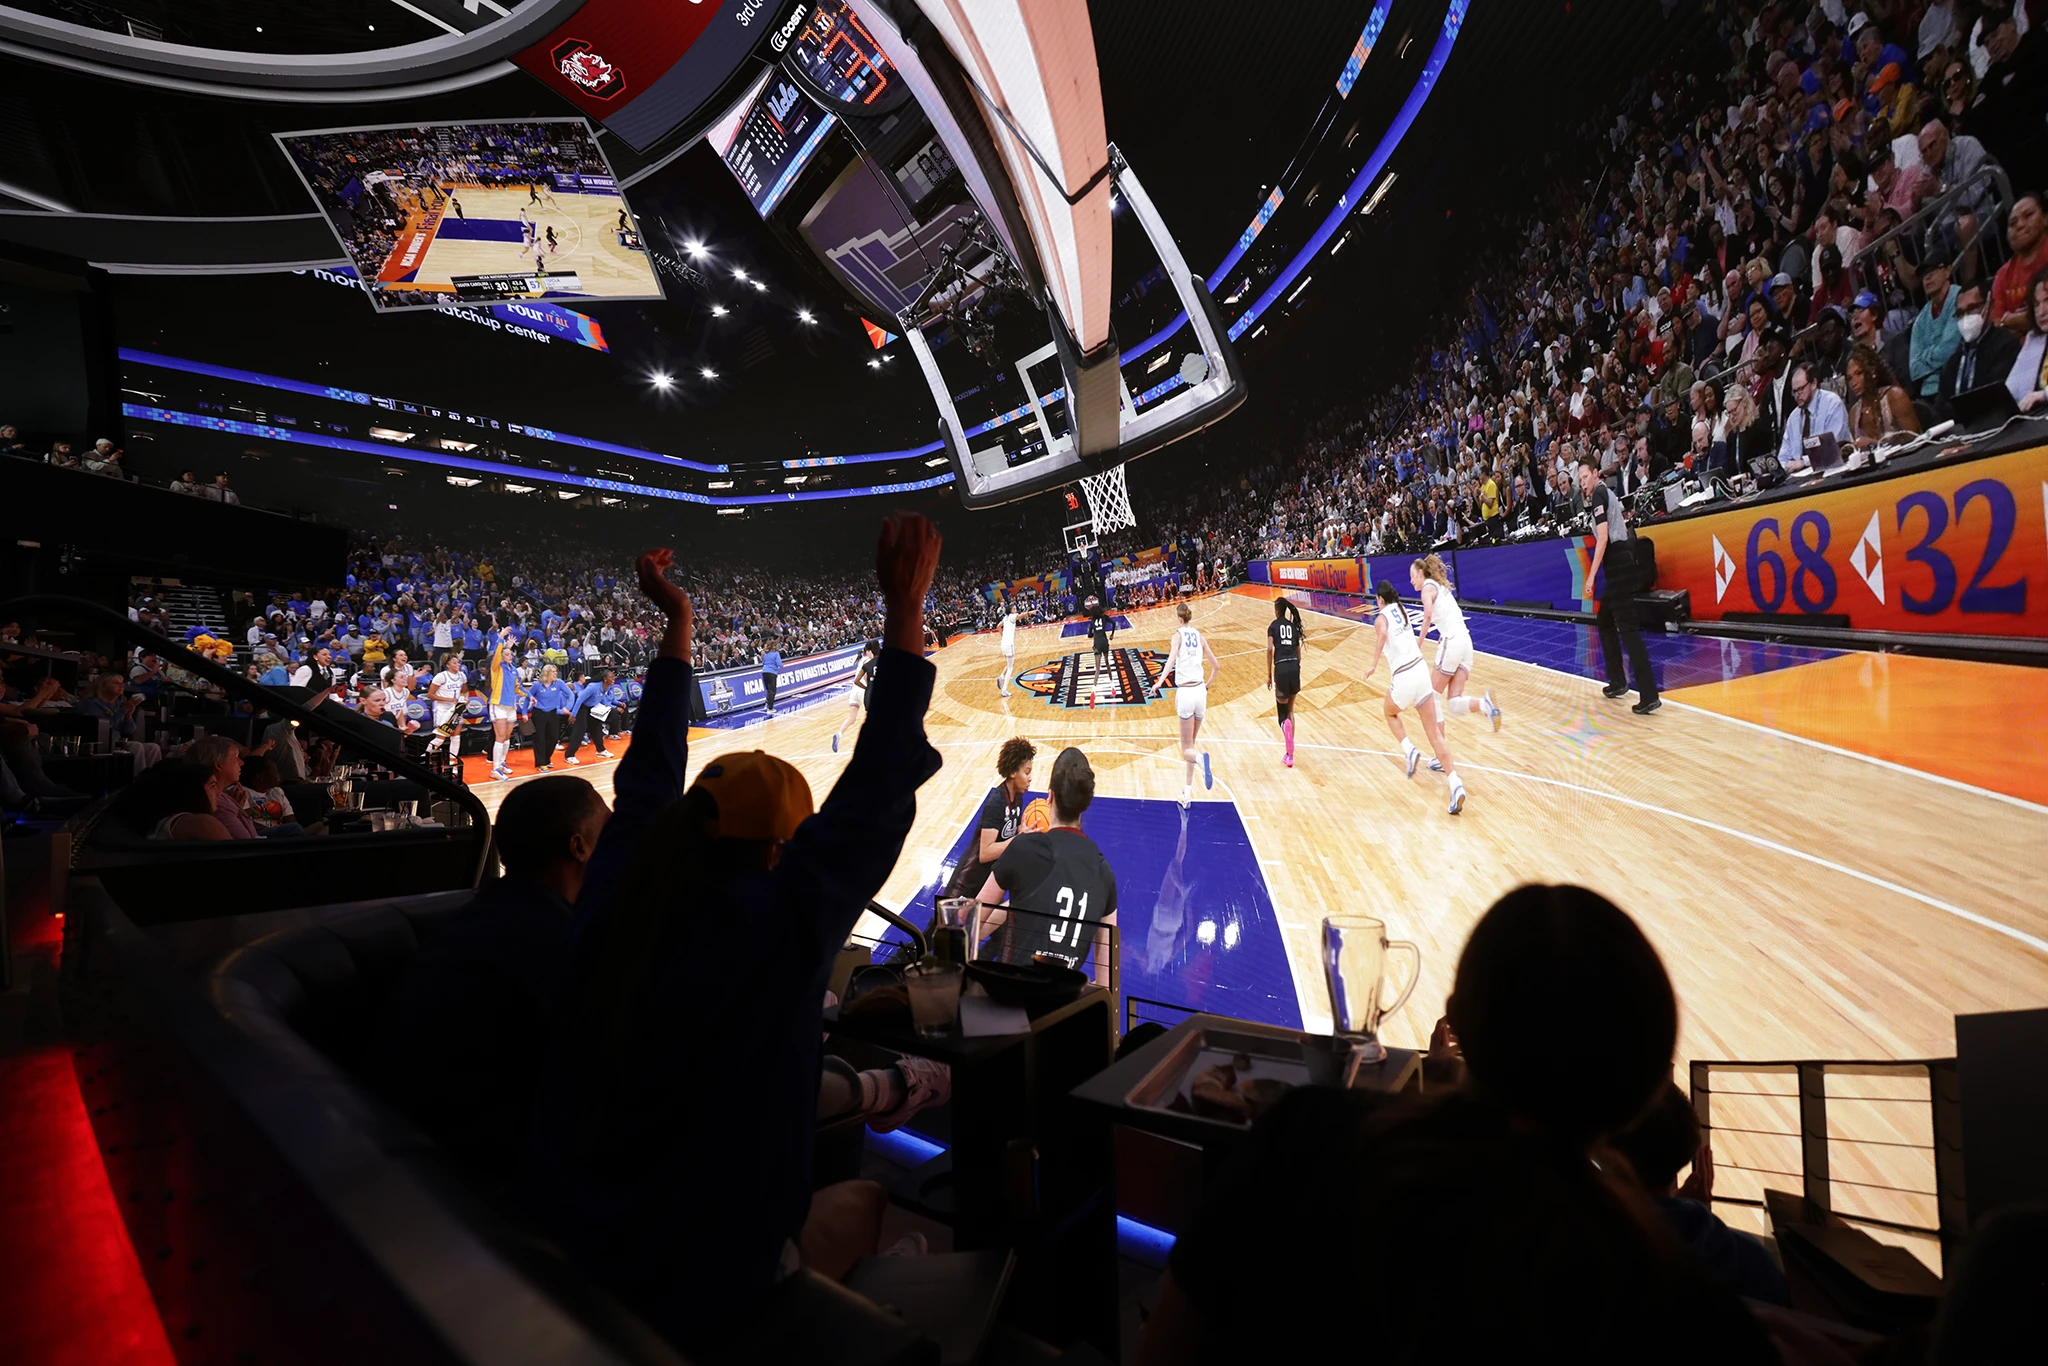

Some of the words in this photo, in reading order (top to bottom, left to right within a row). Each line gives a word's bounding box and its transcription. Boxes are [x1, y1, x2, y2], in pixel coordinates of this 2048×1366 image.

[735, 2, 755, 27] 3rd
[781, 3, 808, 38] cosm
[767, 82, 800, 122] Ucla
[496, 281, 509, 291] 30
[531, 280, 541, 289] 57
[432, 306, 501, 331] atchup
[504, 323, 551, 344] center
[545, 313, 554, 323] IT
[554, 316, 570, 329] ALL
[1744, 510, 1839, 614] 68
[1896, 478, 2027, 616] 32
[1309, 562, 1328, 587] Final
[1328, 562, 1347, 589] Four
[1390, 608, 1403, 625] 5
[1184, 631, 1199, 648] 33
[1279, 624, 1293, 640] 00
[743, 678, 765, 696] NCAA
[776, 670, 795, 688] MEN'S
[795, 662, 828, 683] GYMNASTICS
[1074, 671, 1124, 705] FINAL
[1049, 886, 1089, 948] 31
